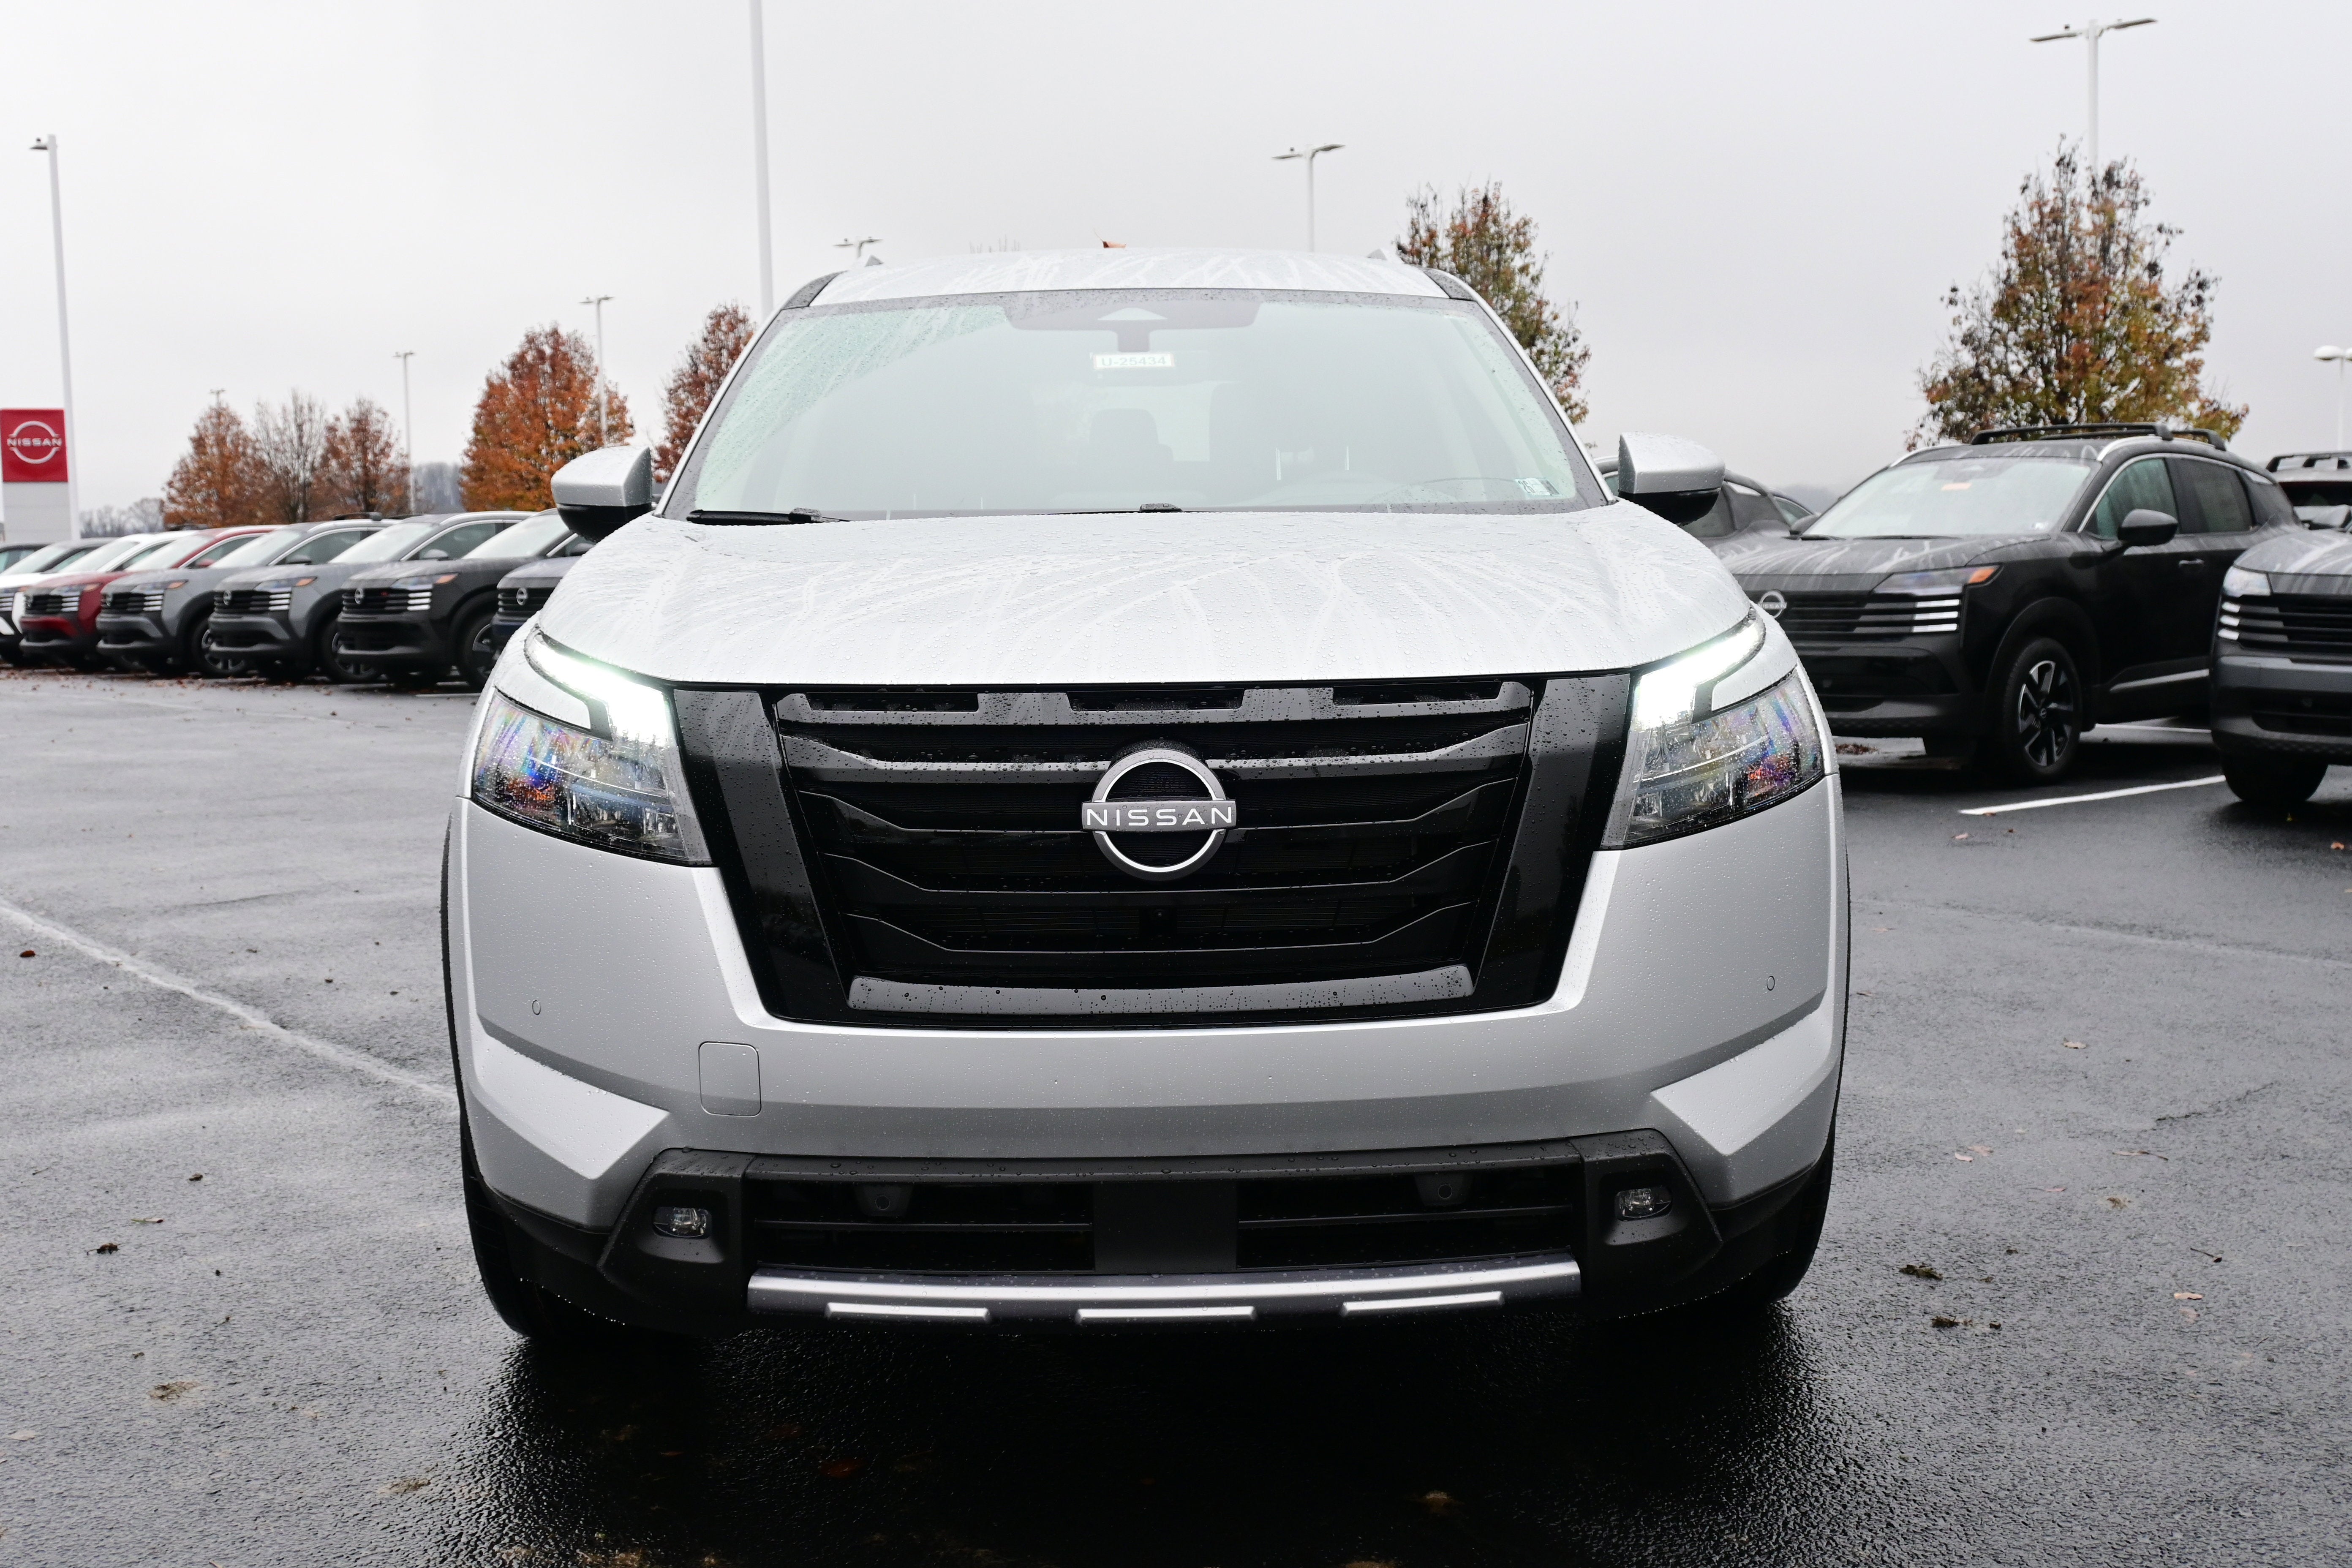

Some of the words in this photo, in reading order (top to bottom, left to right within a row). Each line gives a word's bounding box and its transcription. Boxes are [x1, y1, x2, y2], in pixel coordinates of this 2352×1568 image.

[1101, 357, 1167, 366] U-25434
[7, 438, 62, 446] NISSAN
[1087, 806, 1232, 826] NISSAN
